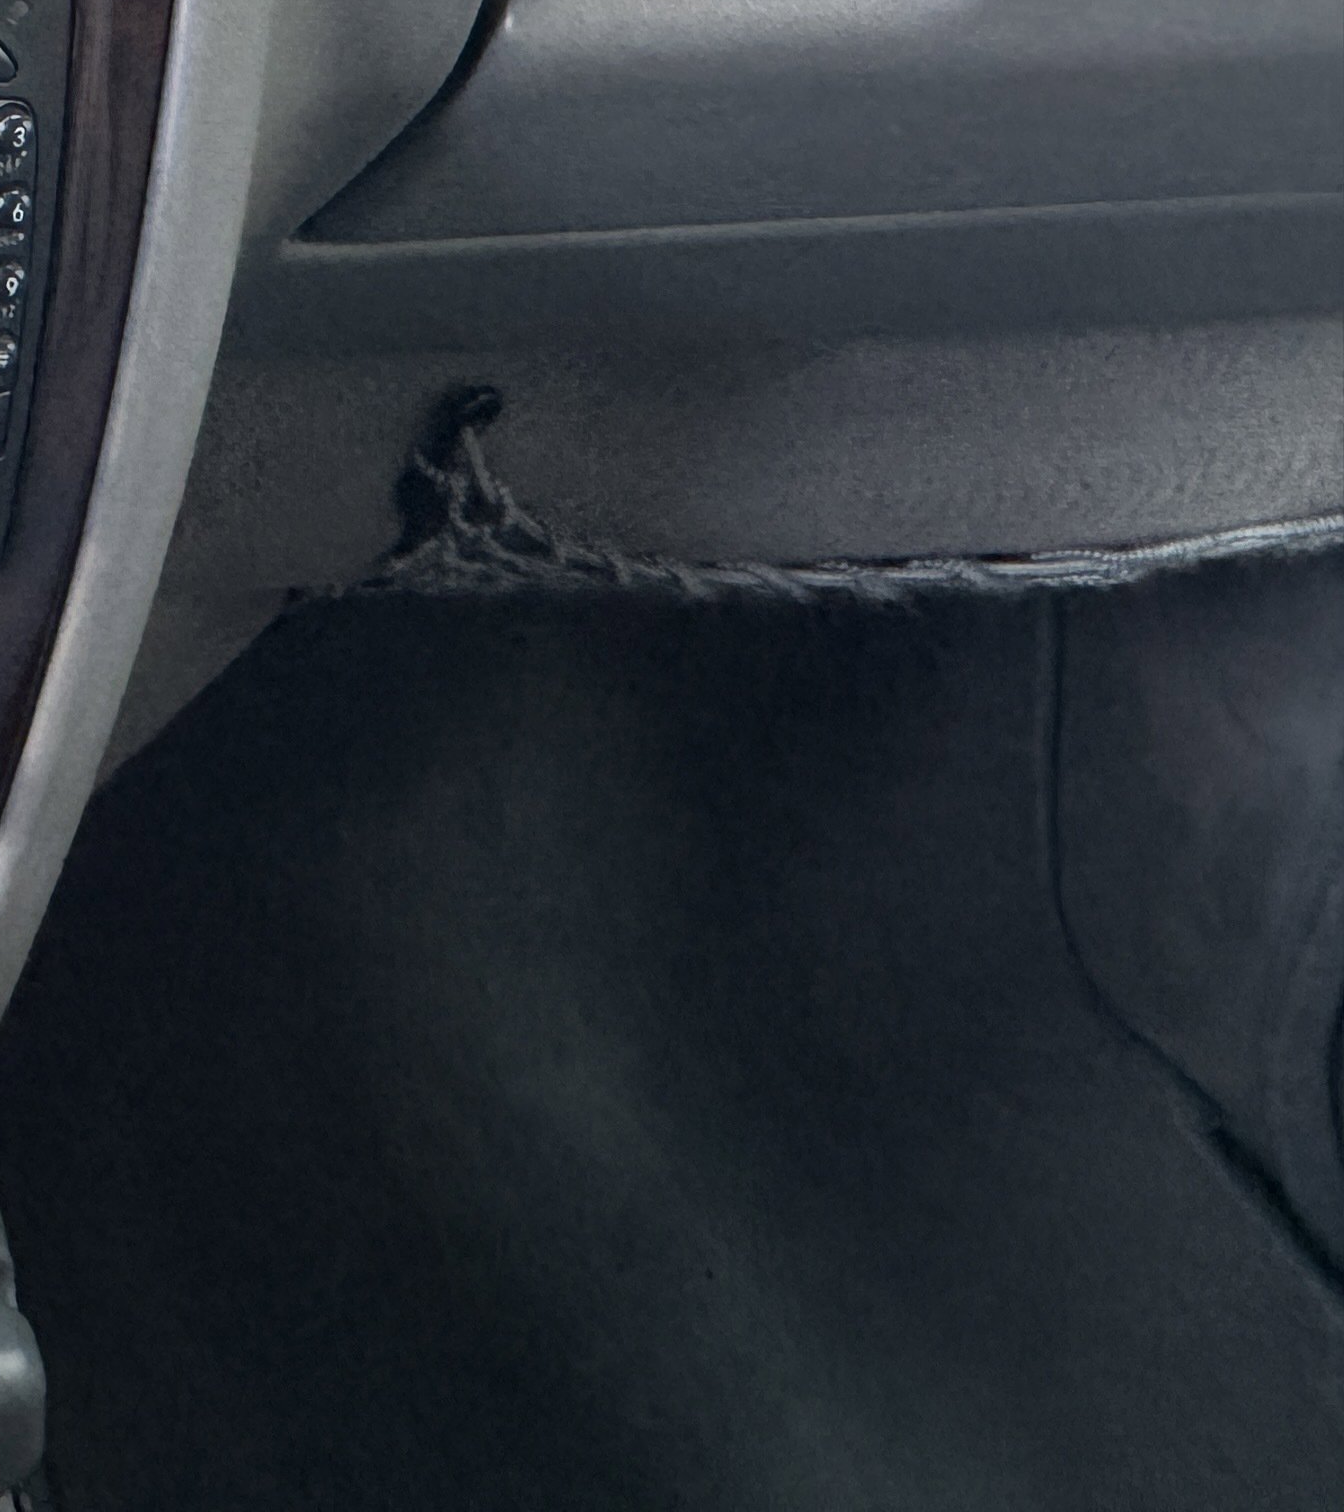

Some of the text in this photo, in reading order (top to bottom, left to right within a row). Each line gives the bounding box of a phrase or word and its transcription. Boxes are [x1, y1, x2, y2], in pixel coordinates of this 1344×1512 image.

[12, 126, 26, 148] 3
[12, 202, 25, 223] 6
[5, 276, 20, 297] 9
